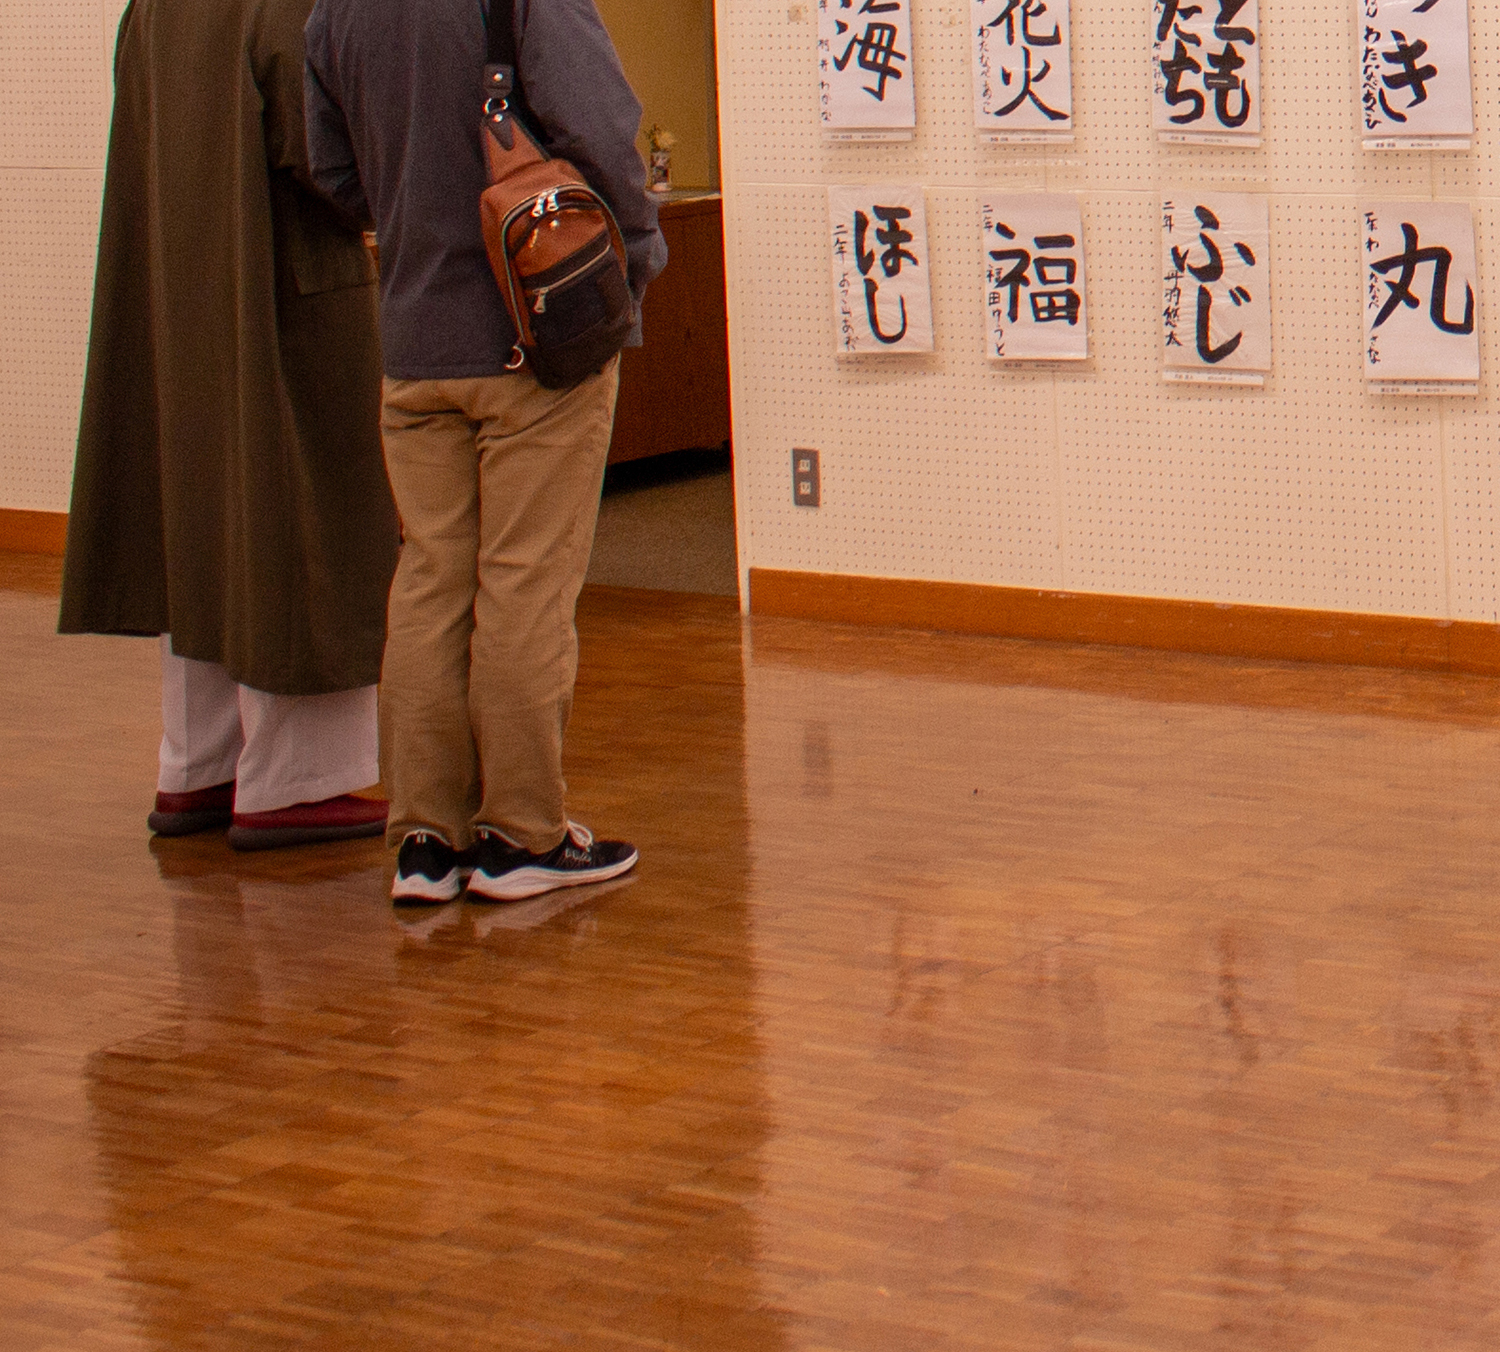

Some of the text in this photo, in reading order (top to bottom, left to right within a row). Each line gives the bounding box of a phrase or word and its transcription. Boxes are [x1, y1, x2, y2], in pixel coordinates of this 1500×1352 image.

[833, 224, 848, 264] 二年
[1161, 201, 1175, 234] 二年
[853, 204, 919, 344] ほし
[988, 222, 1082, 326] 福
[1172, 205, 1256, 364] ふじ
[1369, 222, 1474, 335] 丸
